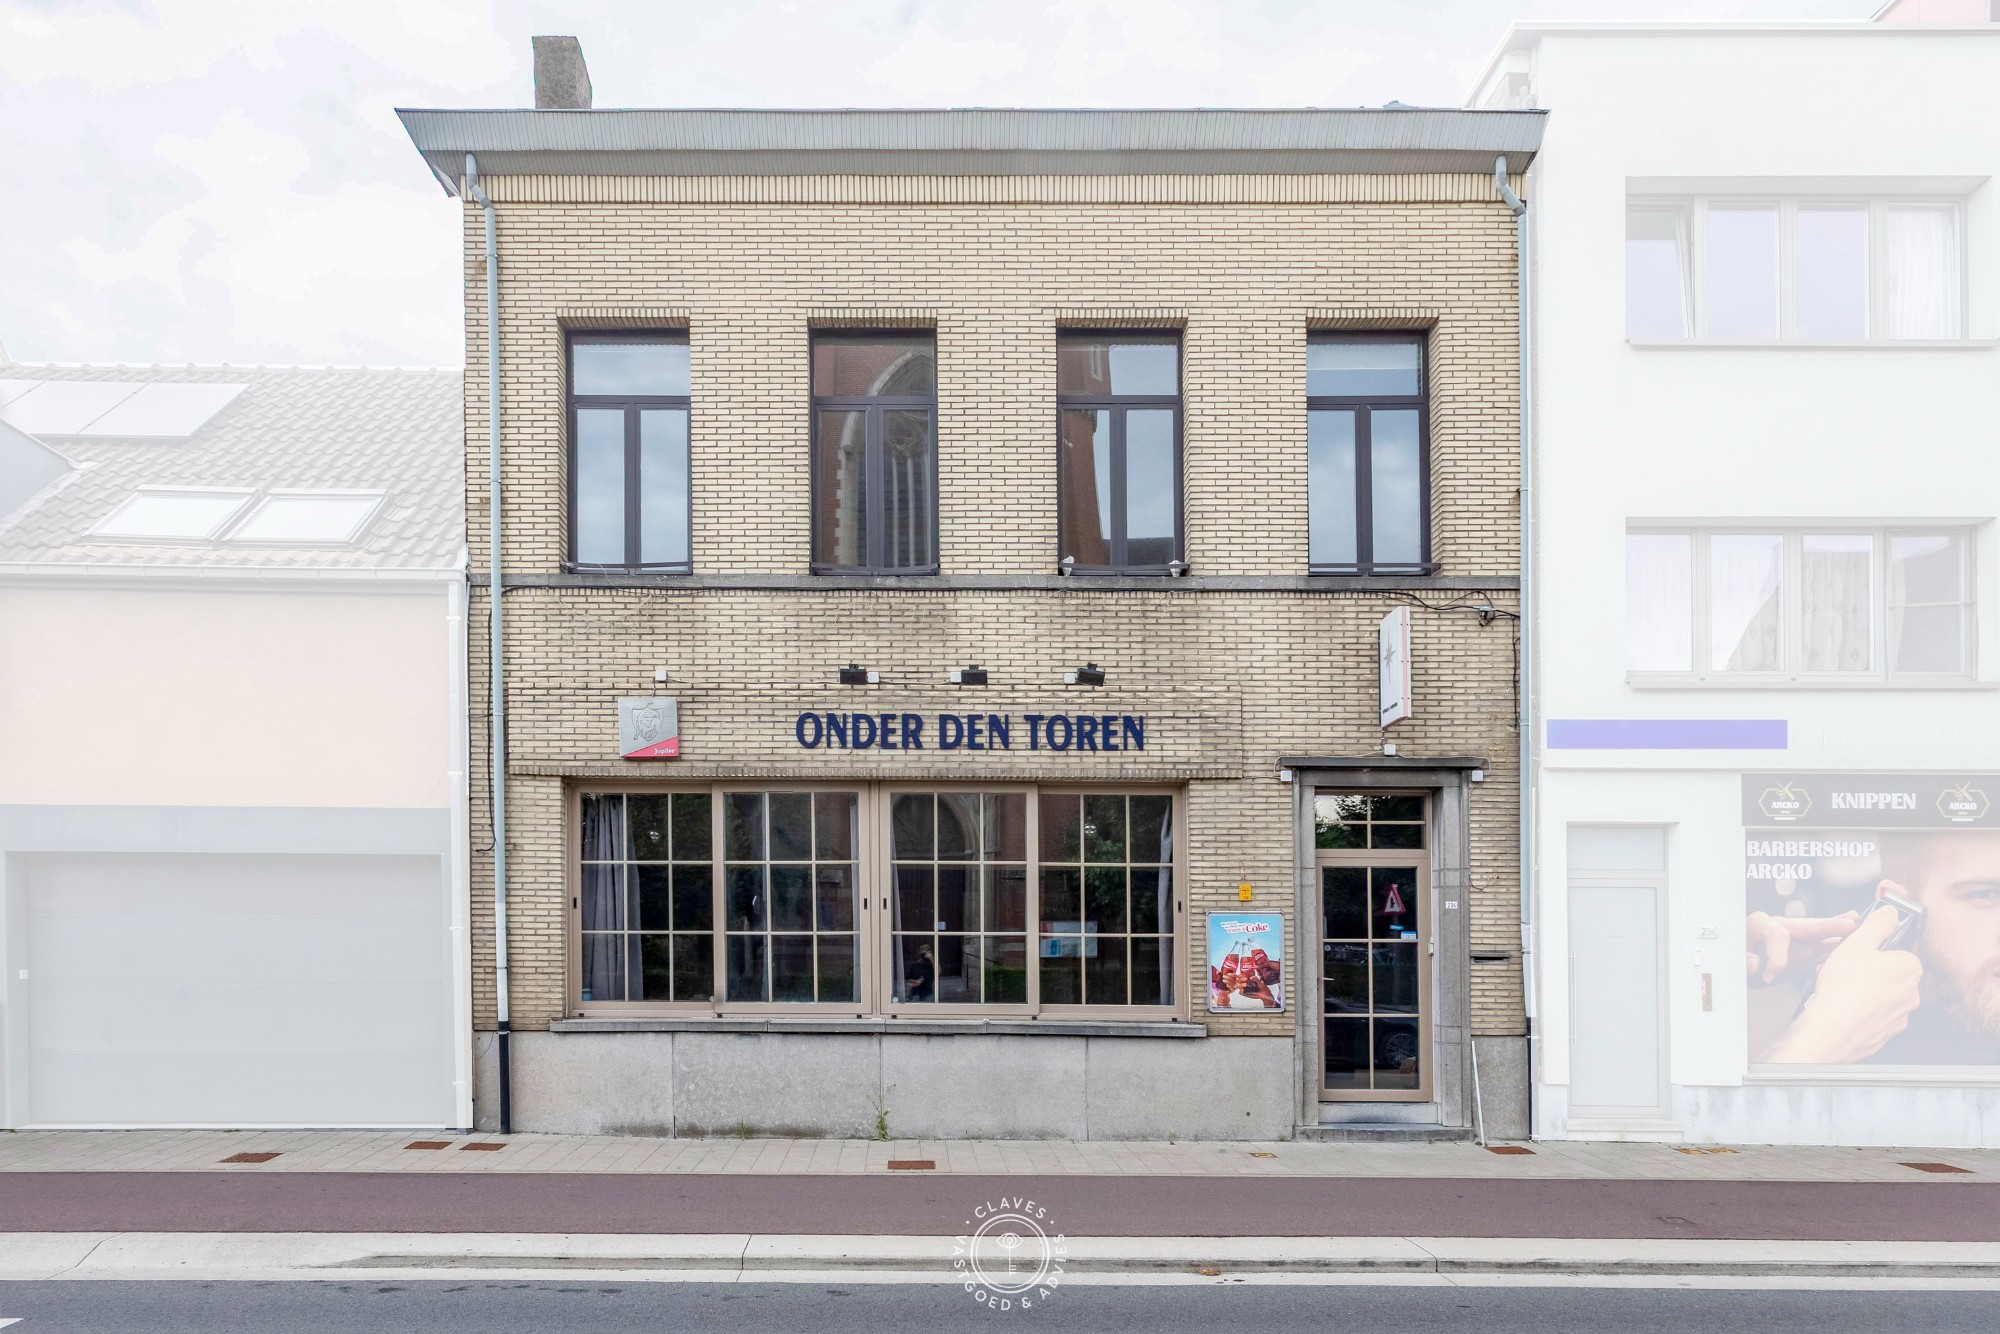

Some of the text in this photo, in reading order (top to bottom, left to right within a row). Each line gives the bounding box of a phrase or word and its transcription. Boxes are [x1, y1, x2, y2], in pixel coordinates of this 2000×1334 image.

[795, 711, 1145, 752] ONDER DEN TOREN
[1771, 801, 1800, 809] ARCKO
[1831, 792, 1916, 810] KNIPPEN
[1948, 802, 1978, 810] ARCKO
[1747, 840, 1876, 858] BARBERSHOP
[1747, 863, 1812, 880] ARCKO
[1246, 923, 1268, 932] Coke
